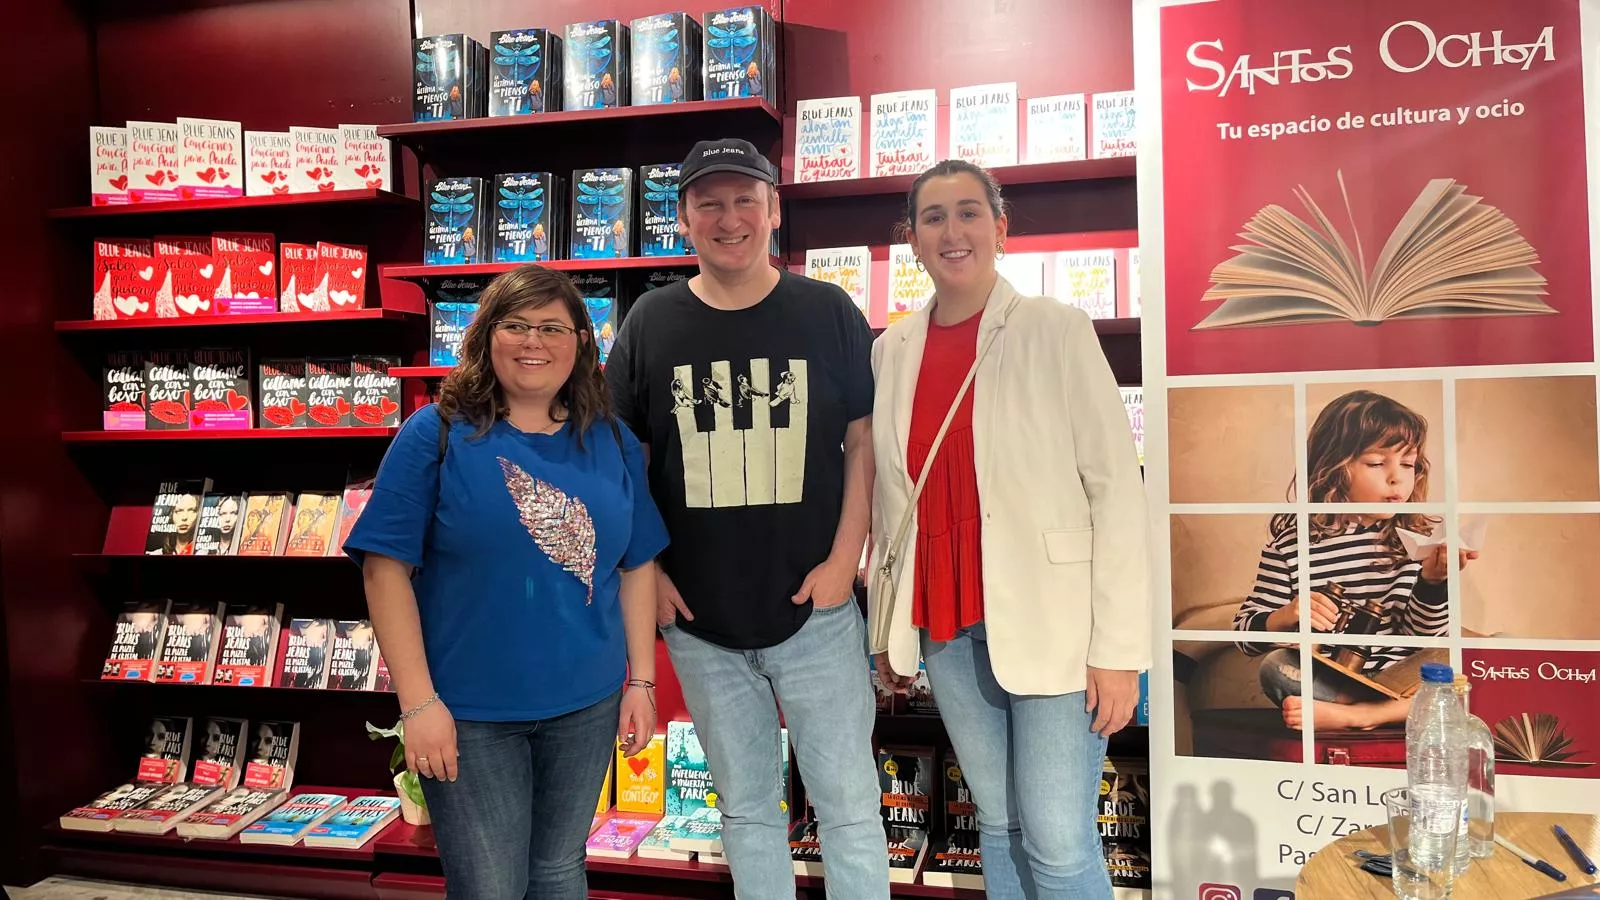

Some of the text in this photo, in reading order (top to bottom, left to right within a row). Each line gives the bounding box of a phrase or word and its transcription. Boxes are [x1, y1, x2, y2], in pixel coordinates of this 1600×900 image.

[877, 100, 929, 115] BLUE JEANS
[956, 93, 1010, 108] BLUE JEANS
[1031, 100, 1080, 115] BLUE JEANS
[1096, 99, 1116, 110] BLUE
[802, 107, 853, 121] BLUE JEANS
[1217, 98, 1525, 140] Tu espacio de cultura y ocio
[96, 132, 116, 146] BLUE
[132, 127, 154, 141] BLUE
[184, 124, 235, 140] BLUE JEANS
[296, 132, 337, 145] BLUE JEANS
[344, 130, 361, 141] BLUE
[702, 147, 745, 157] Blue Jeans
[876, 150, 929, 165] tuitear
[800, 155, 853, 170] tuitear
[812, 168, 856, 181] quiero
[99, 242, 121, 257] BLUE
[158, 240, 182, 255] BLUE
[217, 237, 271, 253] BLUE JEANS
[285, 247, 303, 260] BLUE
[321, 246, 363, 260] BLUE JEANS
[811, 255, 861, 269] BLUE JEANS
[263, 376, 306, 391] Cállame
[308, 374, 351, 389] Cállame
[353, 373, 397, 389] Cállame
[159, 482, 178, 494] BLUE
[117, 622, 136, 634] BLUE
[168, 624, 187, 636] BLUE
[226, 626, 244, 638] BLUE
[114, 634, 140, 645] JEANS
[166, 636, 192, 648] JEANS
[224, 638, 251, 650] JEANS
[288, 635, 306, 646] BLUE
[334, 637, 353, 648] BLUE
[286, 647, 311, 659] JEANS
[332, 649, 356, 661] JEANS
[165, 731, 181, 742] BLUE
[220, 734, 235, 745] BLUE
[271, 736, 287, 747] BLUE
[891, 780, 920, 796] BLUE
[1278, 779, 1304, 801] C/
[1312, 782, 1356, 804] San
[888, 807, 925, 823] JEANS
[1104, 801, 1135, 816] BLUE
[1101, 823, 1140, 839] JEANS
[1296, 814, 1324, 836] C/
[938, 859, 982, 868] JEANS
